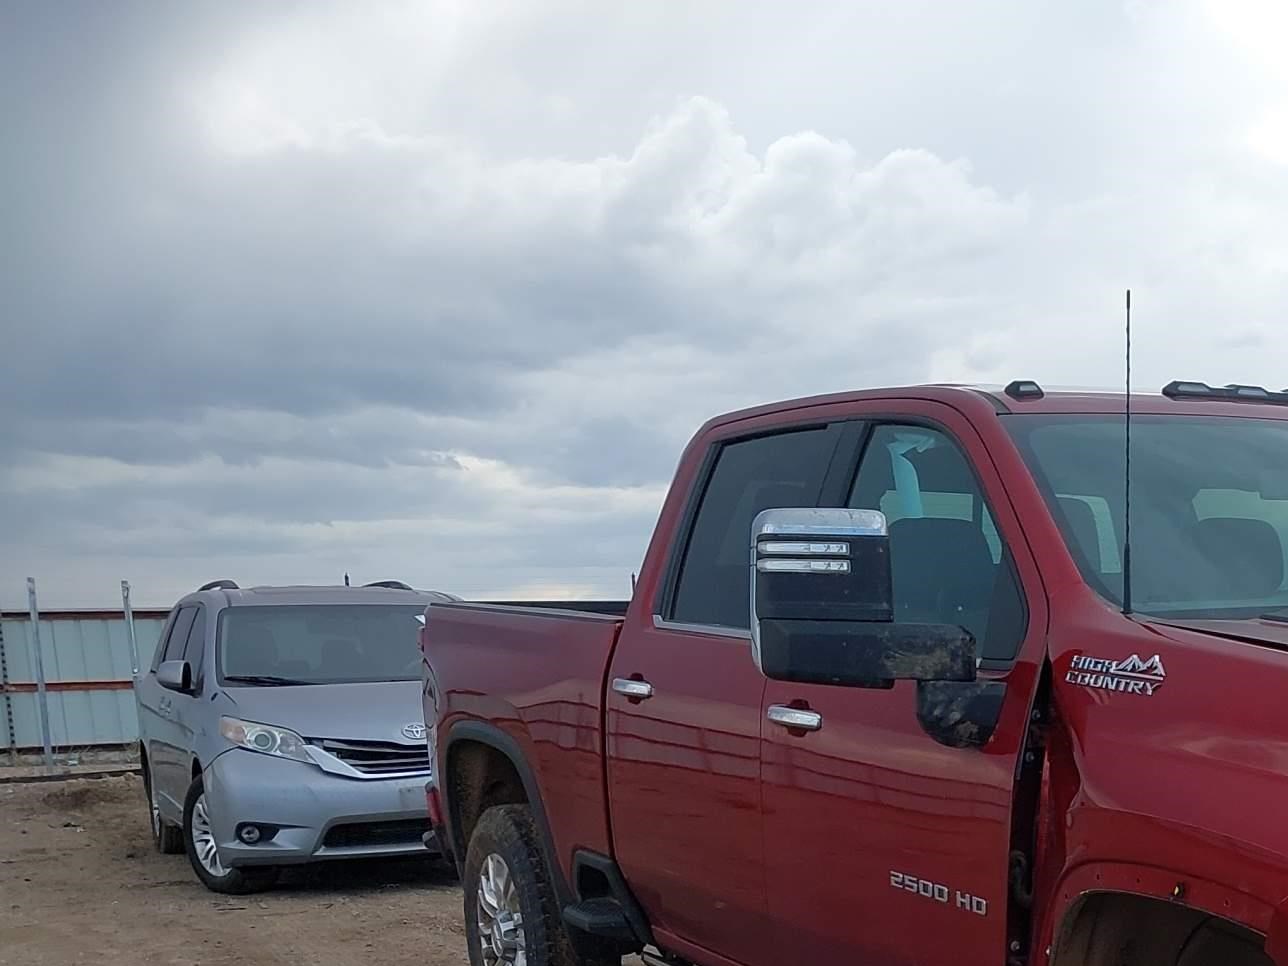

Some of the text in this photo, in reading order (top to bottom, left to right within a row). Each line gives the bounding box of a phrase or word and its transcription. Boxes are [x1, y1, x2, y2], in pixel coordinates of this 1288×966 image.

[1071, 655, 1118, 673] HIGH
[1065, 671, 1162, 696] COUNTRY
[890, 870, 987, 916] 2500 HD
